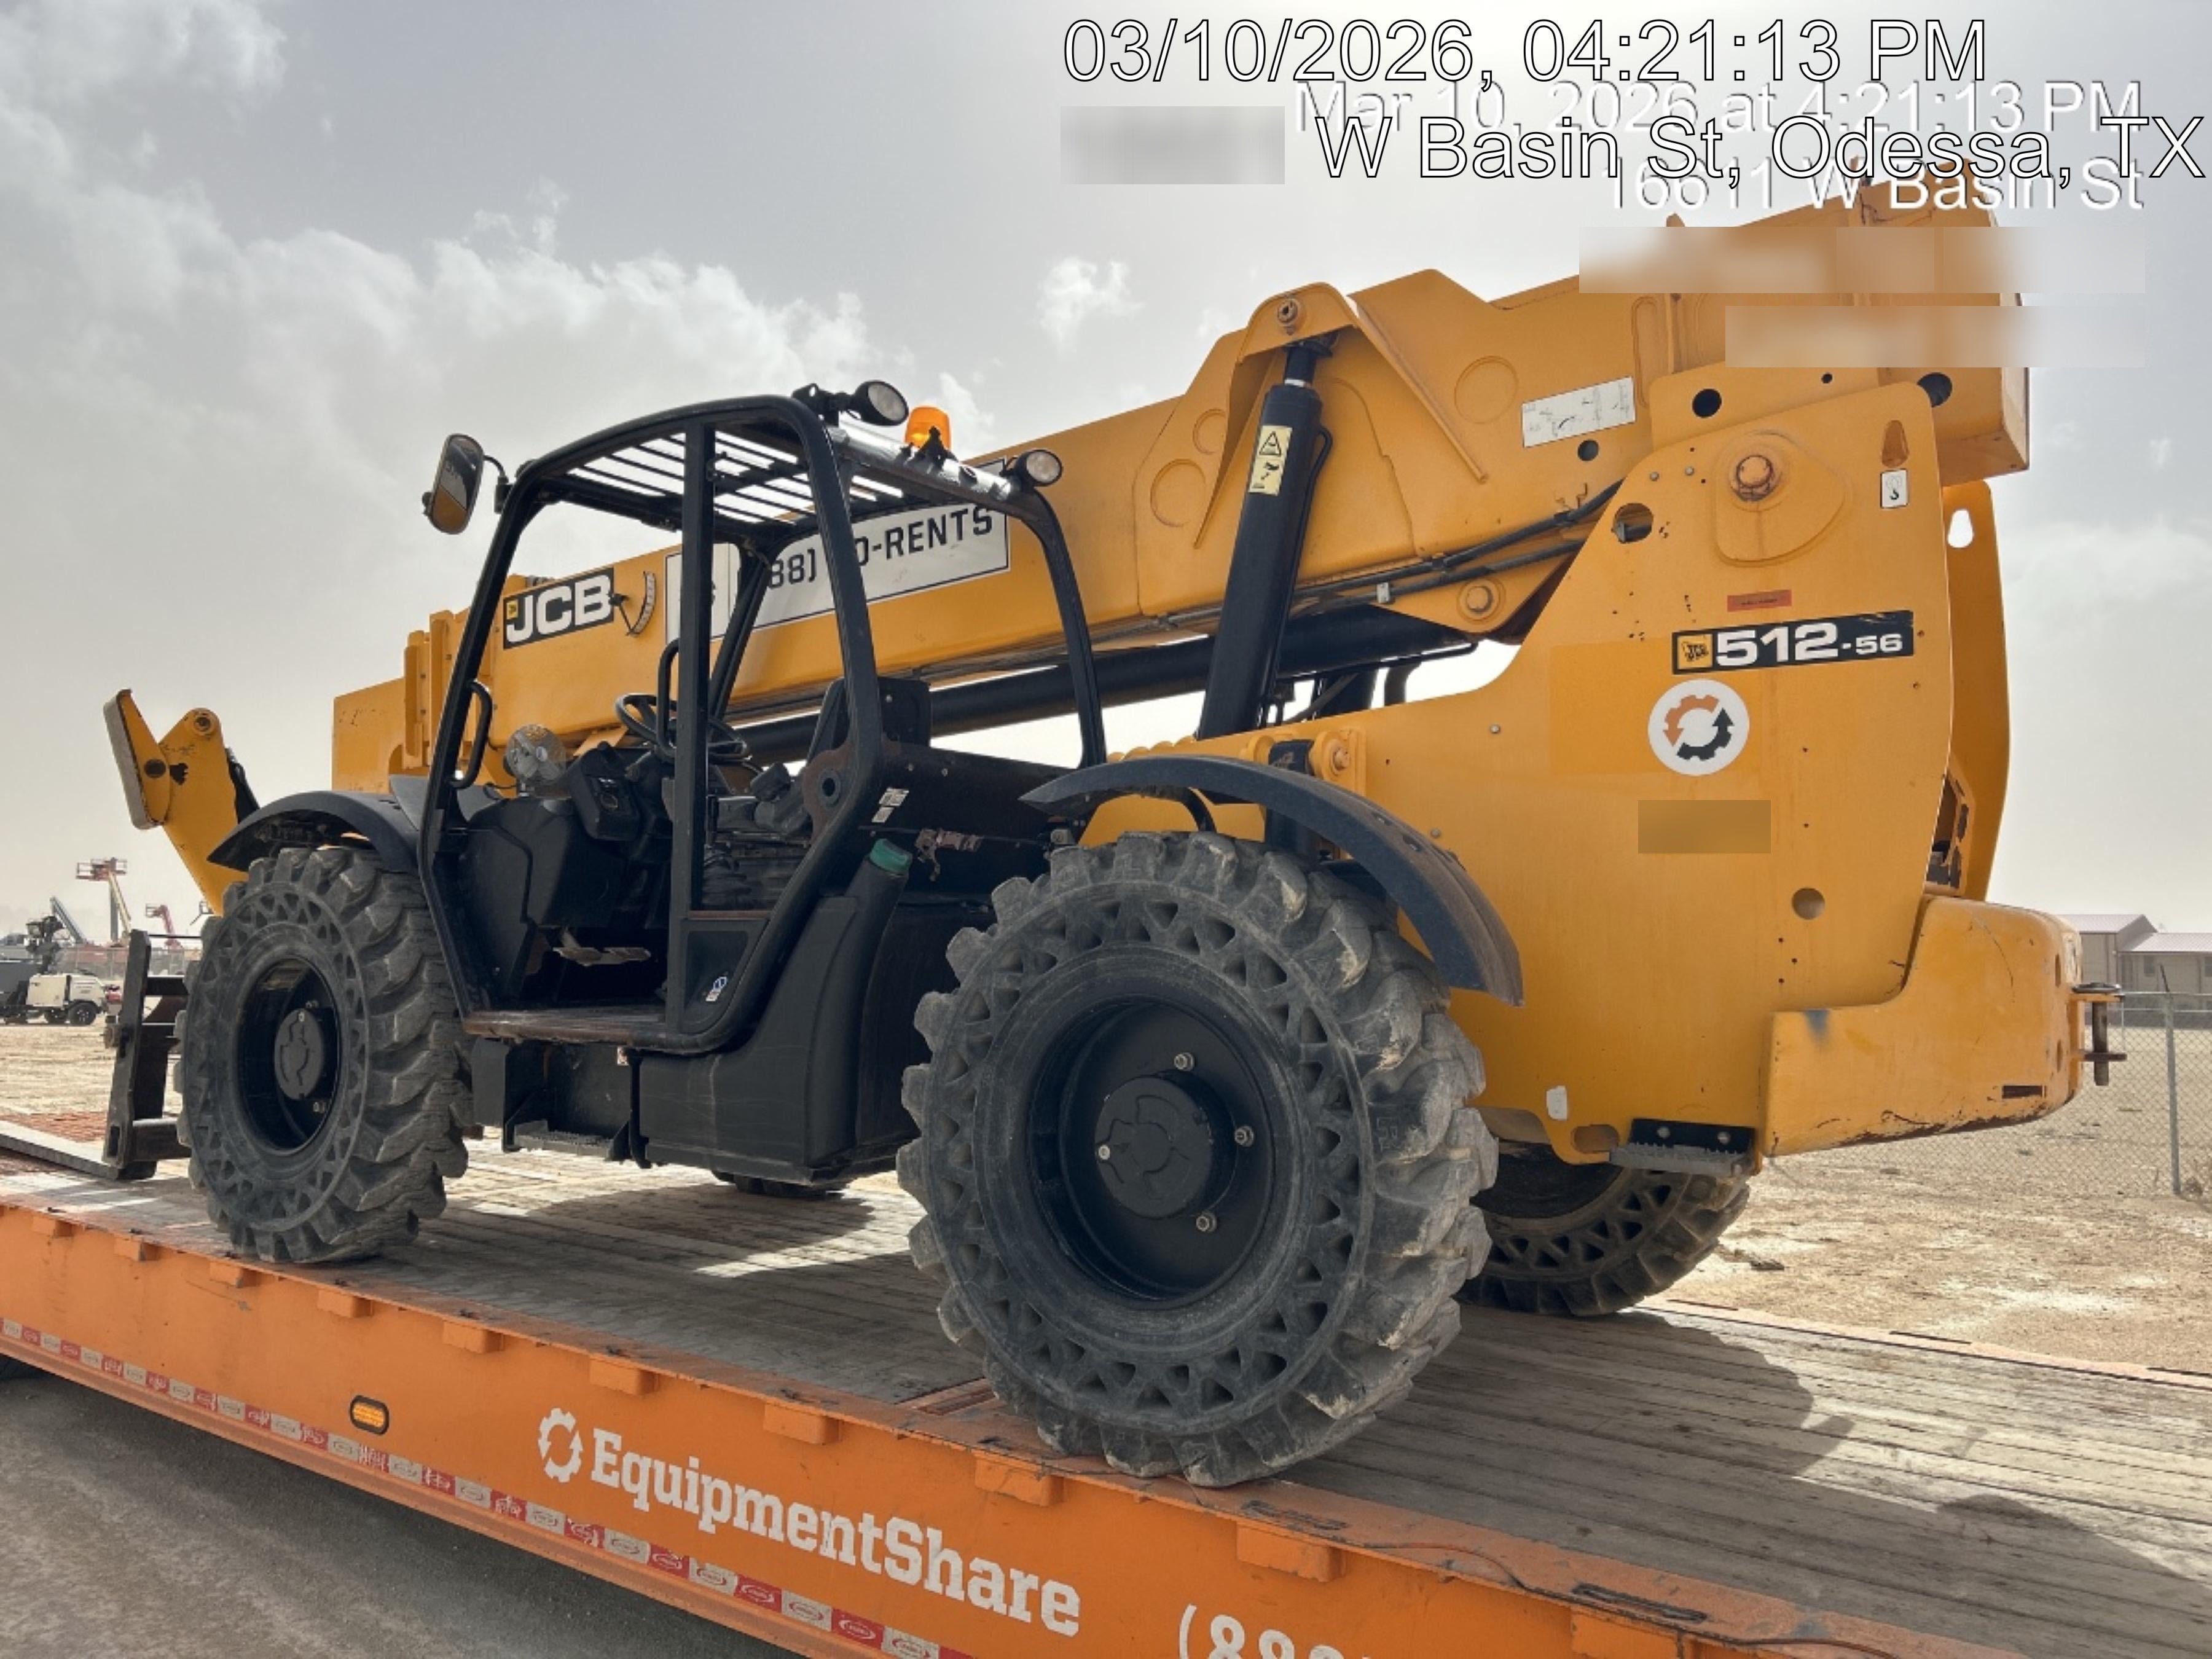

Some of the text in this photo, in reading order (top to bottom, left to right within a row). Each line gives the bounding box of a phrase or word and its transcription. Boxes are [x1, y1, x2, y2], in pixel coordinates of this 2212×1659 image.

[768, 548, 816, 589] 88)
[506, 575, 611, 643] JCB
[1717, 622, 1903, 667] 512-56
[590, 1428, 1080, 1637] EquipmentShare
